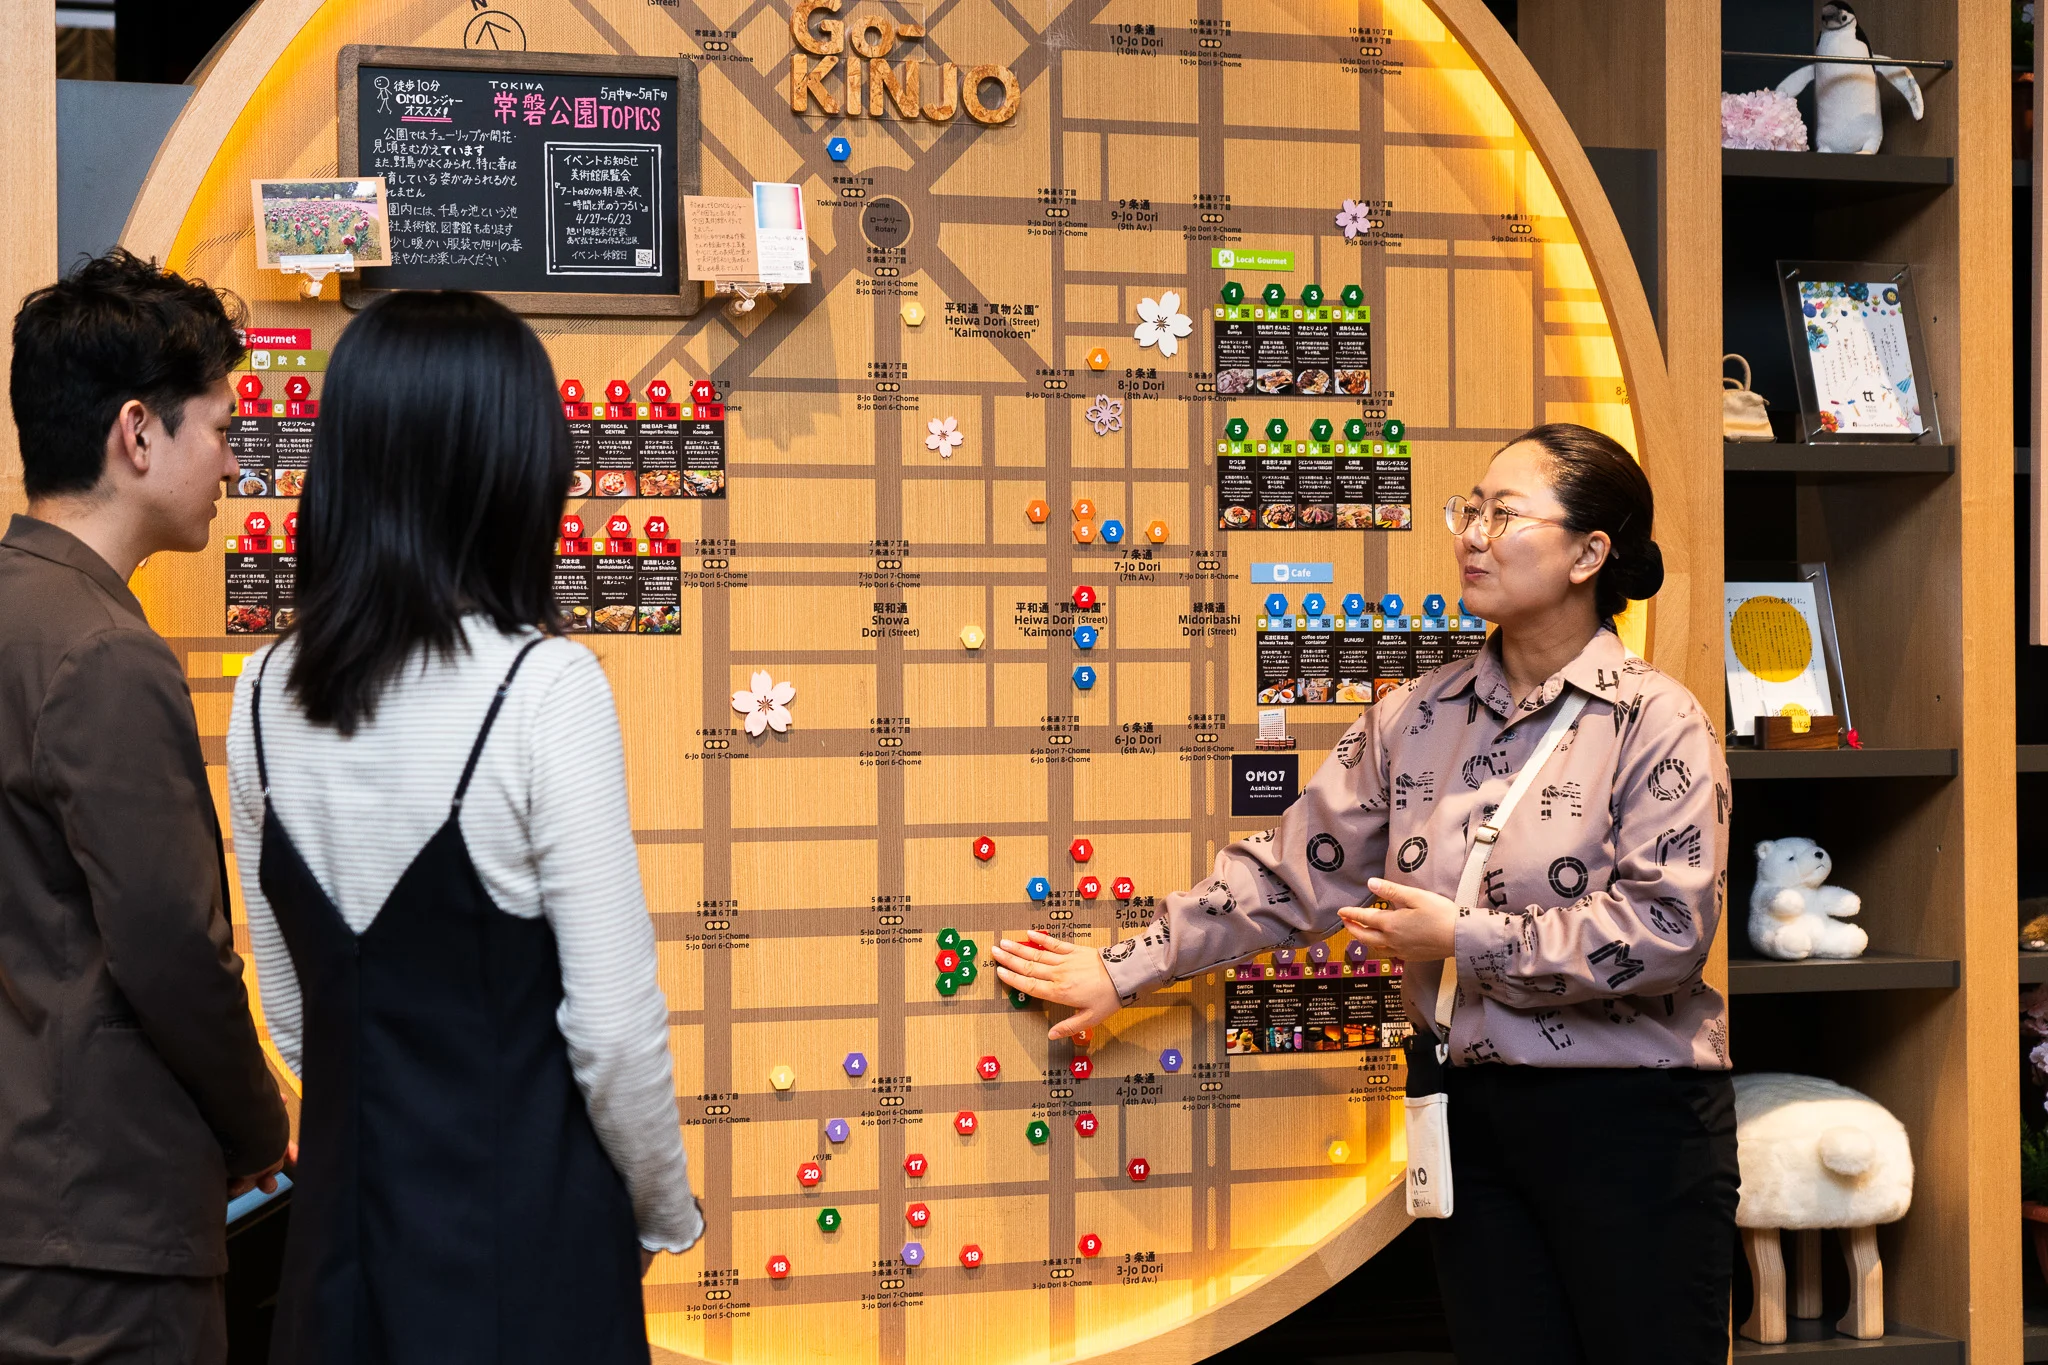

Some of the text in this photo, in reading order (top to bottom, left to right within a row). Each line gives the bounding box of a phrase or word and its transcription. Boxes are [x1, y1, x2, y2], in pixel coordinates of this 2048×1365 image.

[1110, 36, 1164, 47] 10-Jo Dori
[706, 54, 720, 62] Dori
[1116, 48, 1156, 57] (10th Av.)
[394, 79, 440, 92] 徒歩10分
[489, 81, 544, 91] TOKIWA
[790, 53, 1021, 124] KINJO
[396, 94, 463, 106] OMOレンジャー
[834, 143, 844, 154] 4
[564, 155, 638, 166] イベントお知らせ
[571, 168, 631, 182] 美術館展覧会
[1112, 211, 1158, 222] 9-Jo Dori
[875, 226, 897, 234] Rotary
[1118, 223, 1152, 232] (9th Av.)
[1236, 256, 1287, 265] Local Gourmet
[1230, 288, 1237, 298] 1
[945, 302, 978, 314] 平和通
[945, 316, 1040, 327] Heiwa Dori (Street)
[250, 334, 296, 344] Gourmet
[1094, 353, 1103, 364] 4
[245, 381, 253, 393] 1
[651, 386, 667, 397] 10
[696, 386, 709, 397] 11
[1118, 381, 1165, 391] 8-Jo Dori
[1124, 392, 1159, 401] (8th Av.)
[1234, 424, 1242, 435] 5
[1391, 425, 1399, 435] 9
[250, 518, 266, 529] 12
[564, 521, 579, 533] 19
[612, 520, 628, 532] 20
[649, 521, 665, 533] 21
[1114, 562, 1160, 572] 7-Jo Dori
[1291, 568, 1311, 577] Cafe
[684, 572, 698, 580] 7-Jo
[1120, 573, 1155, 582] (7th Av.)
[1080, 591, 1089, 602] 2
[874, 602, 908, 614] 昭和通
[1016, 602, 1049, 613] 平和通
[1432, 599, 1440, 610] 5
[872, 615, 910, 625] Showa
[1015, 615, 1108, 625] Heiwa Dori (Street)
[1178, 615, 1240, 625] Midoribashi
[862, 628, 919, 638] Dori (Street)
[1182, 627, 1236, 636] Dori (Street)
[1081, 671, 1089, 682] 5
[1115, 734, 1161, 746] 6-Jo Dori
[1121, 746, 1156, 755] (6th Av.)
[1245, 771, 1286, 782] OMO7
[1078, 844, 1085, 855] 1
[1035, 882, 1044, 893] 6
[1084, 882, 1098, 893] 10
[1117, 883, 1131, 894] 12
[1116, 909, 1136, 920] 5-Jo
[1122, 921, 1138, 930] (5th
[944, 934, 954, 945] 4
[983, 1062, 997, 1072] 13
[1074, 1061, 1088, 1072] 21
[1116, 1085, 1163, 1097] 4-Jo Dori
[1122, 1097, 1157, 1106] (4th Av.)
[959, 1117, 973, 1128] 14
[1080, 1119, 1094, 1130] 15
[909, 1159, 923, 1171] 17
[1133, 1164, 1145, 1175] 11
[803, 1169, 819, 1180] 20
[911, 1210, 926, 1221] 16
[965, 1251, 979, 1262] 19
[772, 1261, 787, 1273] 18
[1117, 1264, 1163, 1276] 3-Jo Dori
[1123, 1276, 1139, 1285] (3rd
[686, 1304, 700, 1312] 3-Jo
[718, 1302, 750, 1310] 6-Chome
